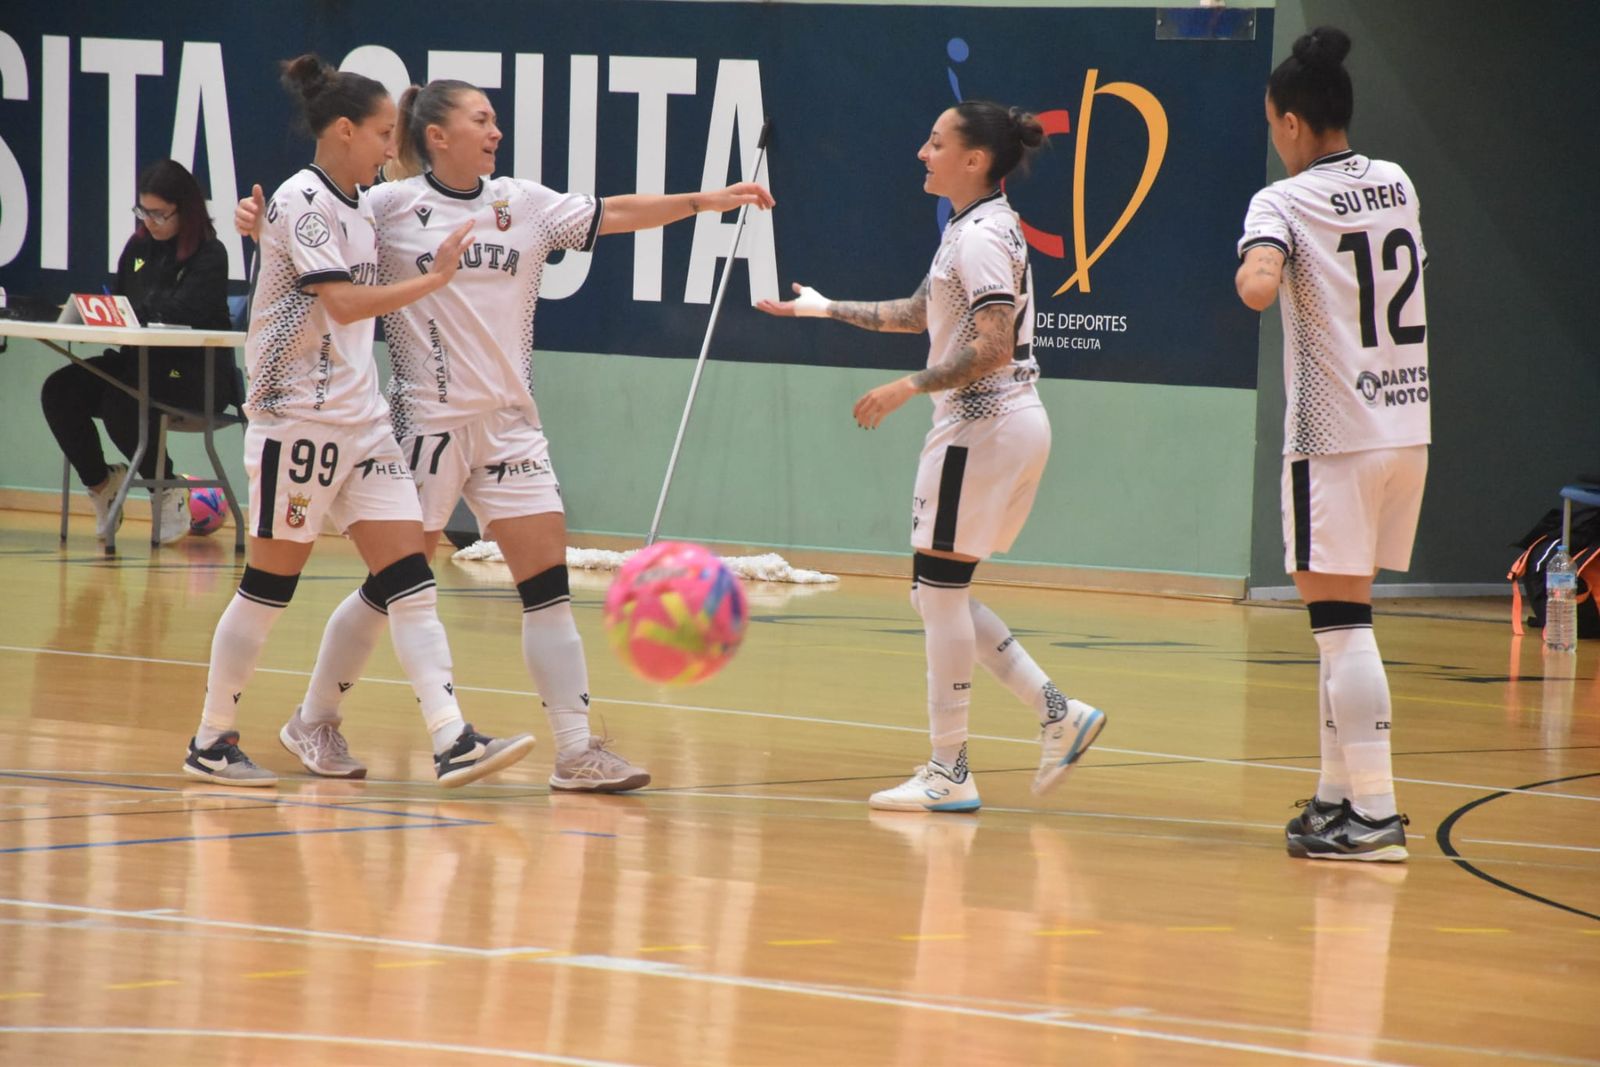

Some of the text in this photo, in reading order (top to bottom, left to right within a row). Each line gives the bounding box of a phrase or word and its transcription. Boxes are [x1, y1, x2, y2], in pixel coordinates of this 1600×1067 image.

[1331, 182, 1407, 215] SU REIS
[415, 243, 520, 276] CUTA
[1336, 227, 1426, 348] 12
[77, 296, 112, 323] 5
[1036, 312, 1128, 332] DE DEPORTES
[318, 333, 332, 375] ALMINA
[1056, 336, 1069, 349] DE
[1071, 337, 1101, 350] CEUTA
[427, 318, 449, 404] PUNTA ALMINA
[313, 377, 328, 411] PUNTA
[1384, 387, 1429, 407] MOTO
[289, 438, 339, 487] 99
